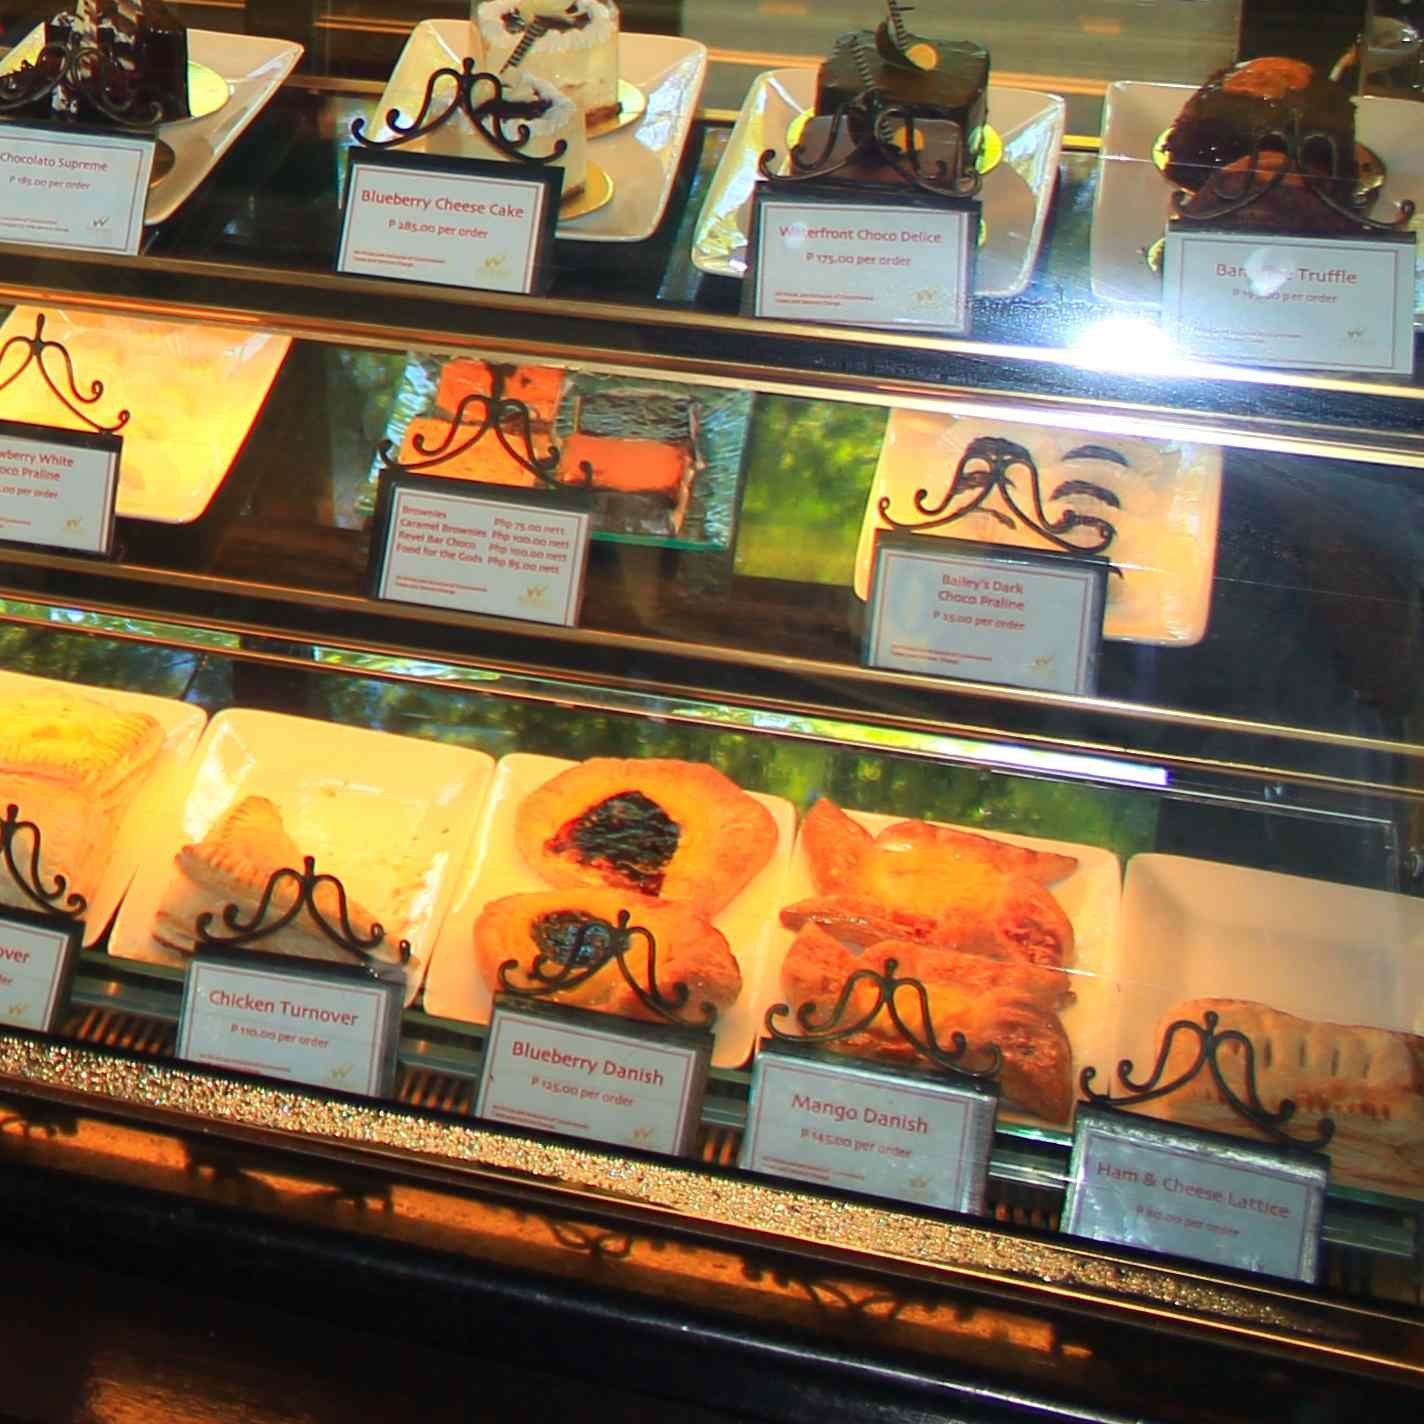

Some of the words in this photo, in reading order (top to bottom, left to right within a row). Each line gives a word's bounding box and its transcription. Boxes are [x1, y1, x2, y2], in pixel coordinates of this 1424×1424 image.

[0, 152, 55, 167] Chocolato
[58, 158, 108, 172] Supreme
[49, 180, 64, 188] per
[361, 189, 432, 210] Blueberry
[435, 197, 486, 214] Cheese
[489, 203, 524, 218] Cake
[437, 225, 456, 236] per
[458, 227, 488, 238] order
[779, 226, 854, 240] Werfront
[857, 228, 896, 241] Choco
[901, 231, 942, 243] Delice
[857, 256, 876, 265] per
[879, 257, 911, 266] order
[1298, 269, 1358, 284] Truffle
[39, 453, 74, 466] White
[22, 467, 61, 481] Praline
[402, 506, 447, 518] Brownies
[494, 518, 512, 530] Php
[400, 518, 440, 530] Caramel
[441, 524, 487, 537] Brownies
[491, 530, 510, 541] Php
[396, 544, 421, 555] Food
[423, 546, 436, 556] for
[488, 556, 506, 568] Php
[489, 543, 507, 554] Php
[943, 574, 990, 590] Bailey's
[993, 580, 1024, 593] Dark
[938, 590, 976, 604] Choco
[980, 596, 1024, 610] Praline
[209, 989, 274, 1013] Chicken
[280, 1001, 359, 1025] Turnover
[277, 1032, 296, 1043] per
[299, 1036, 329, 1049] order
[512, 1040, 598, 1075] Blueberry
[602, 1061, 664, 1086] Danish
[580, 1088, 600, 1100] per
[602, 1093, 635, 1106] order
[791, 1093, 857, 1122] Mango
[863, 1108, 928, 1134] Danish
[854, 1139, 875, 1152] per
[1097, 1161, 1138, 1183] Ham
[1163, 1176, 1224, 1201] Cheese
[1228, 1191, 1290, 1218] Lattice
